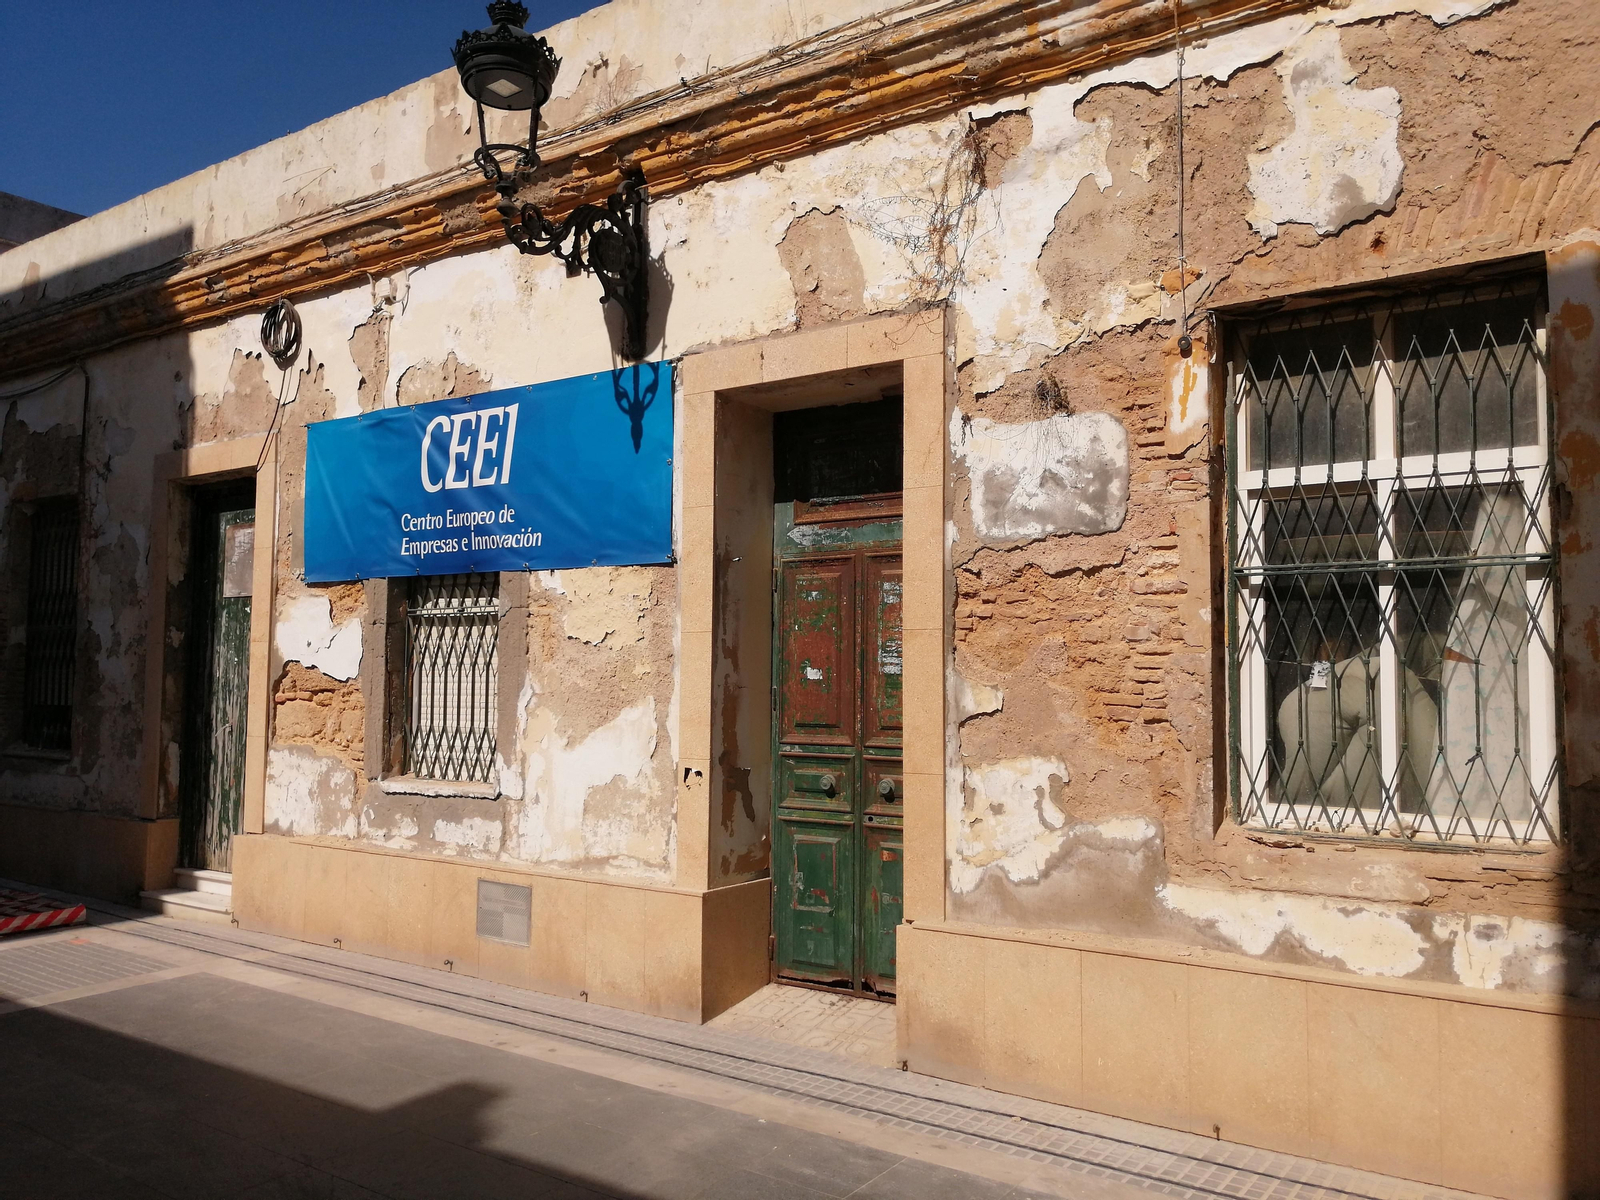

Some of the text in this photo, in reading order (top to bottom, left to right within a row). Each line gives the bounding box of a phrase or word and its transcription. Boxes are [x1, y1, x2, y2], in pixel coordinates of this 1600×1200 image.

[421, 403, 520, 493] CEEI
[401, 504, 516, 532] Centro Europeo de
[400, 527, 542, 559] Empresas e Innovación
